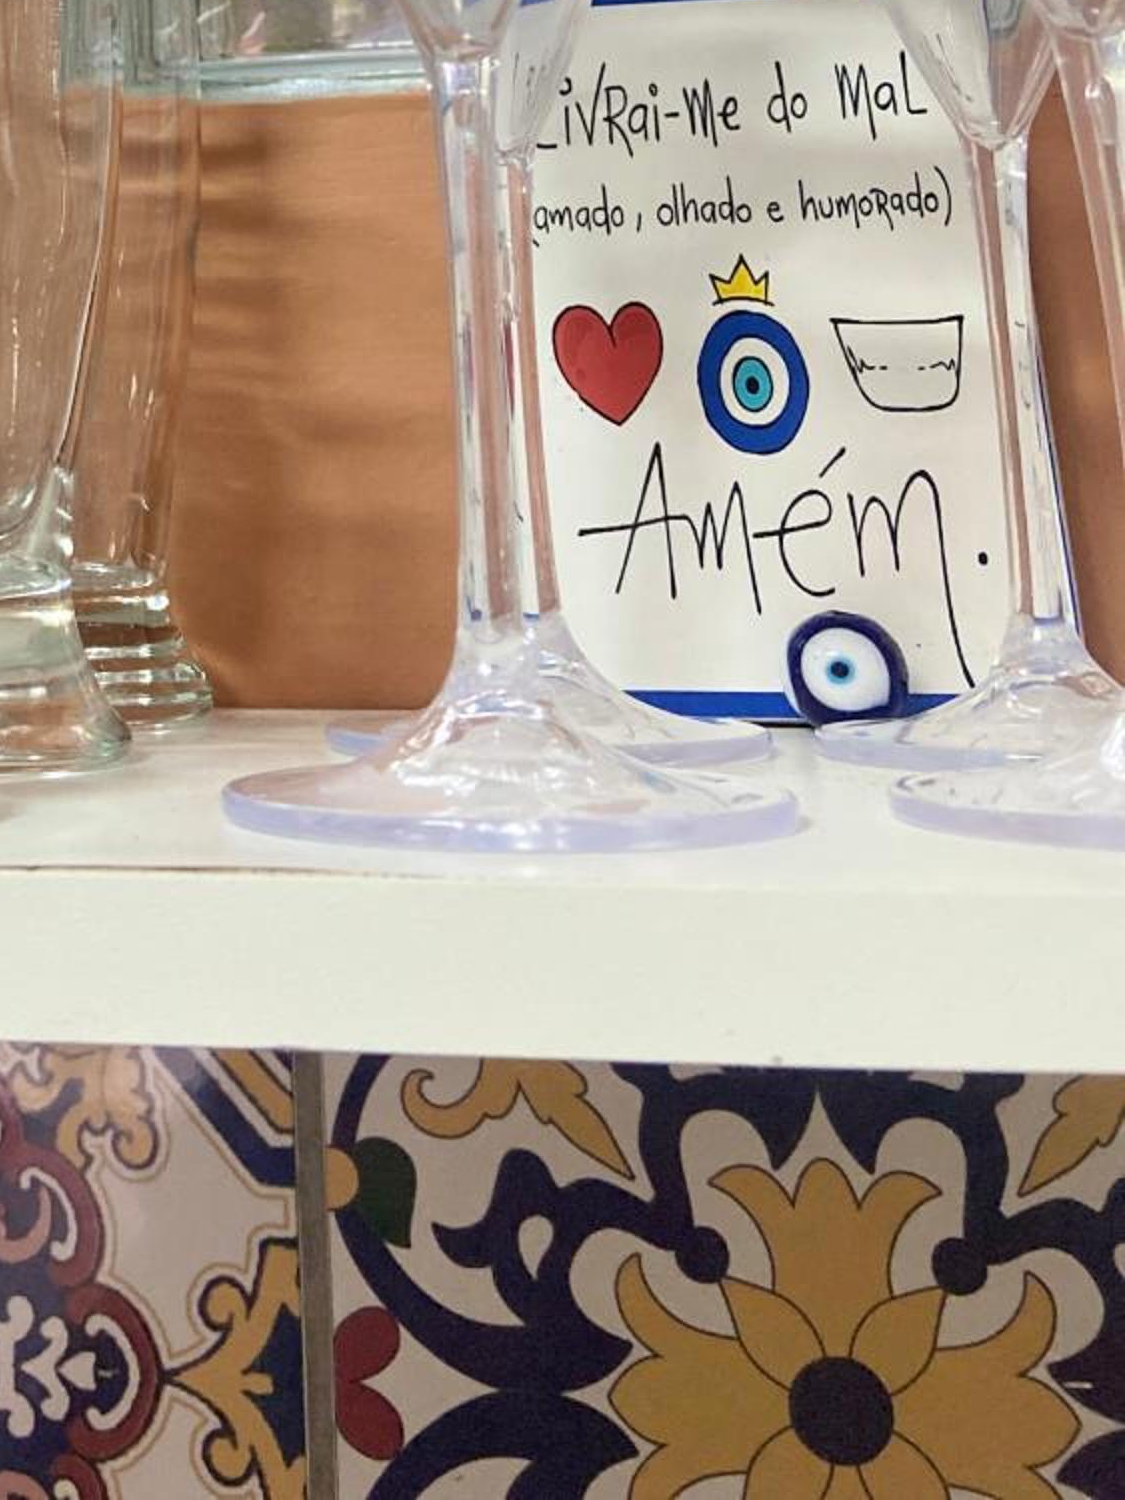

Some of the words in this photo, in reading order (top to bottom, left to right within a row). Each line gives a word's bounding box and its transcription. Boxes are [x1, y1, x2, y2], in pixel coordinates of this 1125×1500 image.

[767, 60, 808, 133] do
[656, 175, 753, 226] olhado
[766, 201, 785, 223] e
